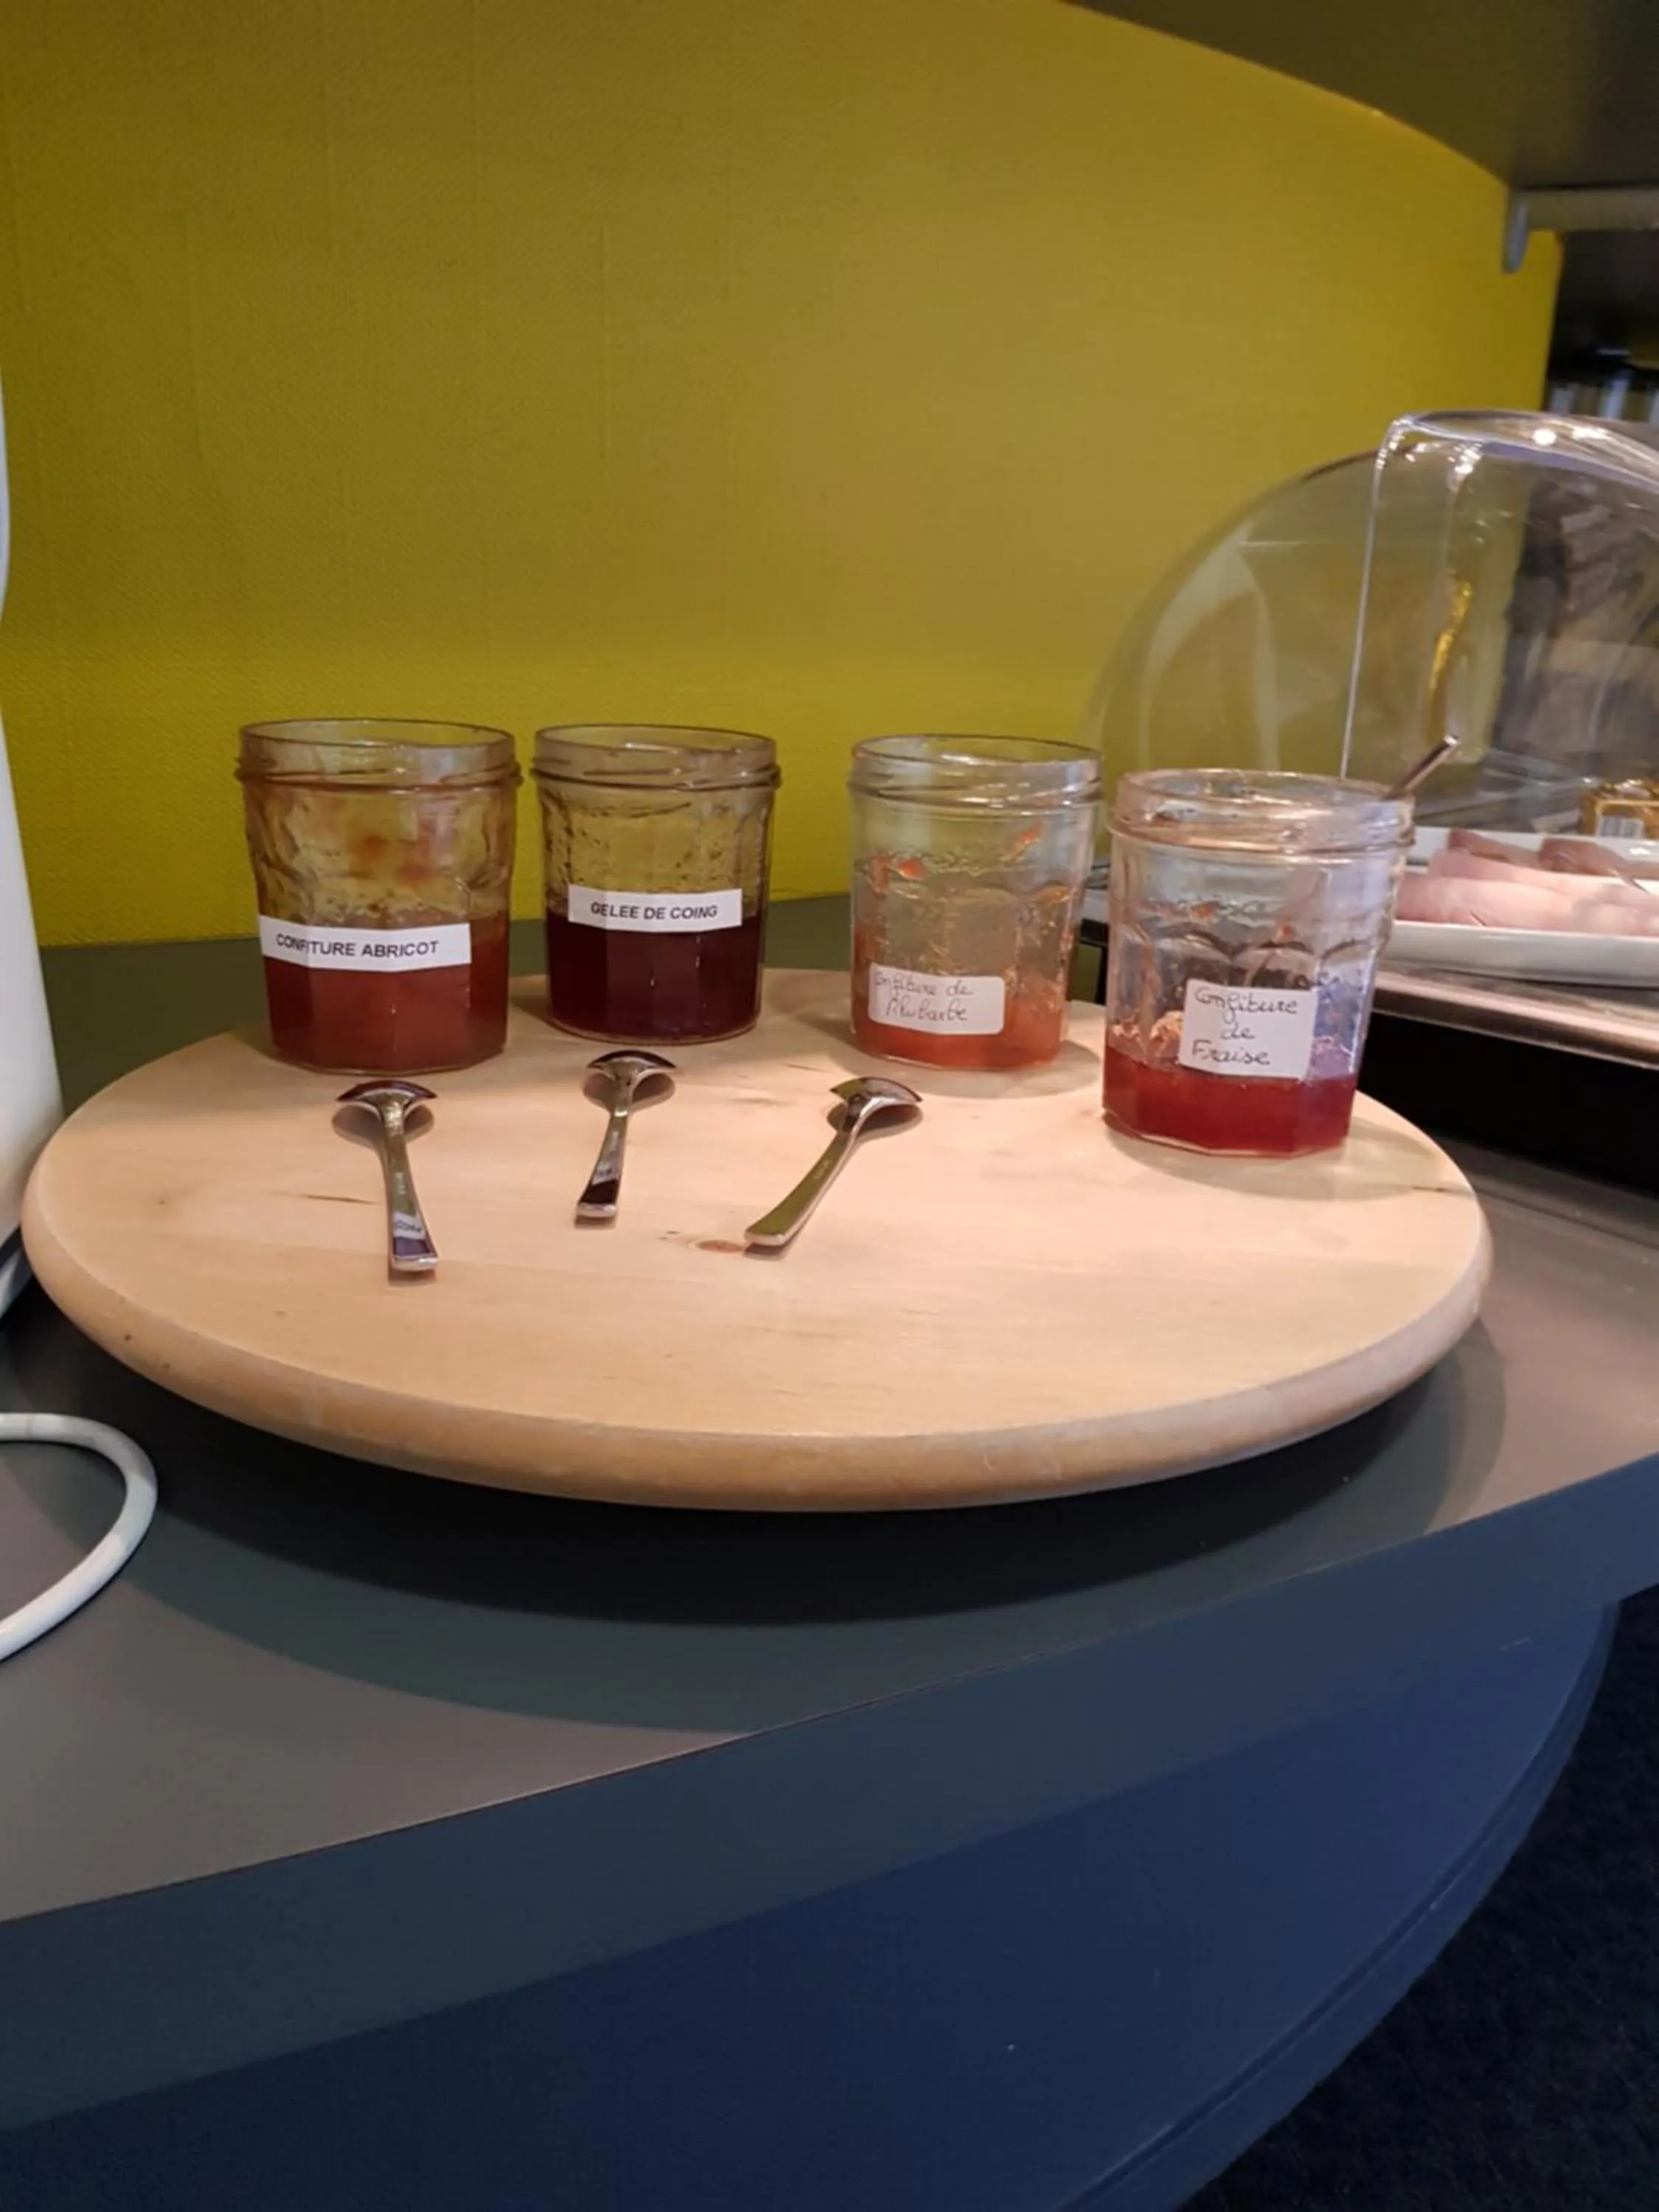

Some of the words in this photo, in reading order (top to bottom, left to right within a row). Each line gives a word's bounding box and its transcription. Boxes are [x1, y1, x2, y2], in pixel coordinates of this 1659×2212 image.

[591, 901, 639, 919] GELEE
[644, 906, 666, 920] DE
[669, 905, 718, 919] COING
[276, 933, 355, 956] CONFITURE
[361, 940, 439, 958] ABRICOT
[946, 979, 973, 996] de
[1194, 986, 1298, 1024] Confiture
[1220, 1023, 1256, 1040] de
[1192, 1039, 1271, 1065] Fraise
